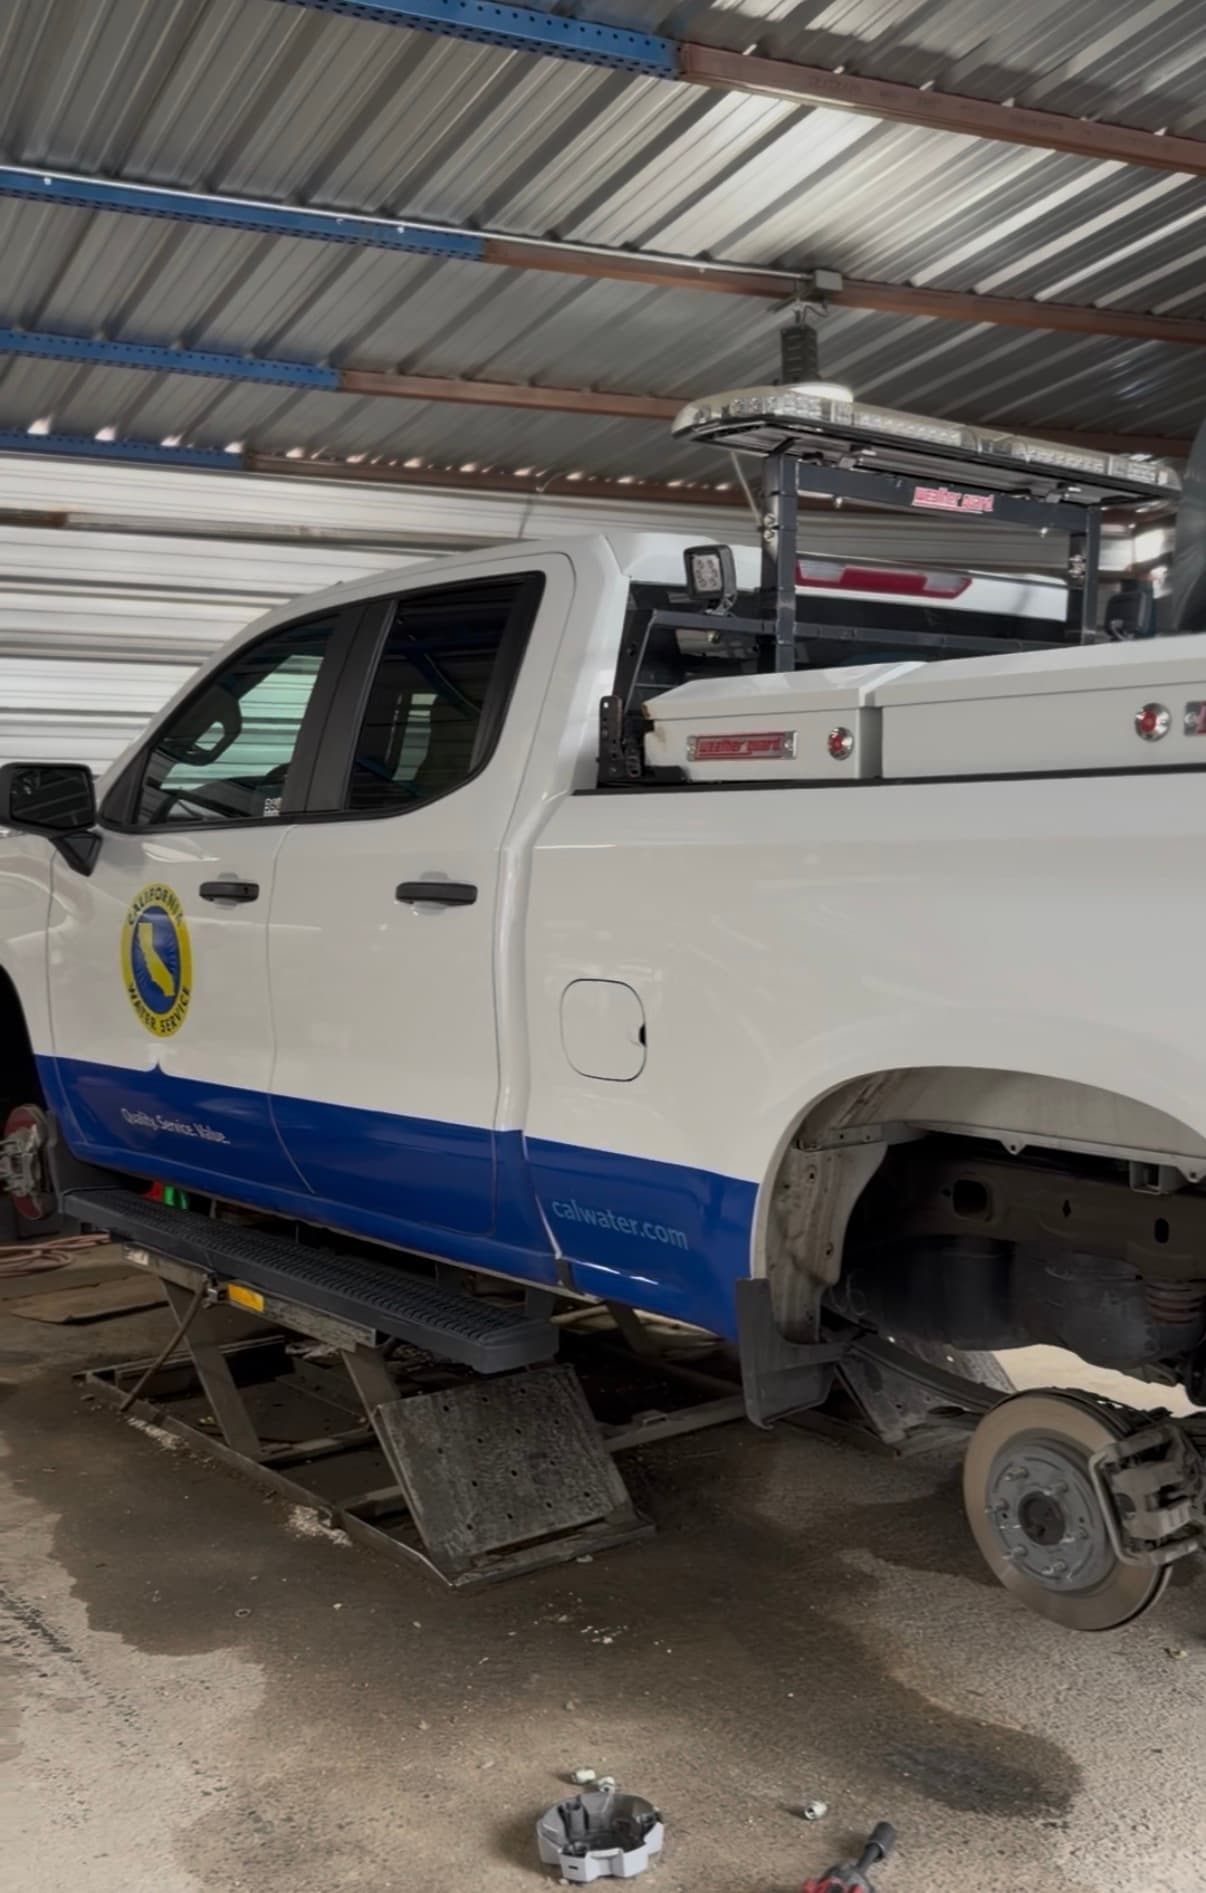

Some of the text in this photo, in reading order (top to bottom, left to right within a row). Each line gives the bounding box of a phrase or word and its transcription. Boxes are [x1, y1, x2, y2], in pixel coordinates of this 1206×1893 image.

[127, 886, 184, 926] CALIFORNIA
[159, 985, 191, 1033] SERVICE
[551, 1199, 689, 1250] calwater.com
